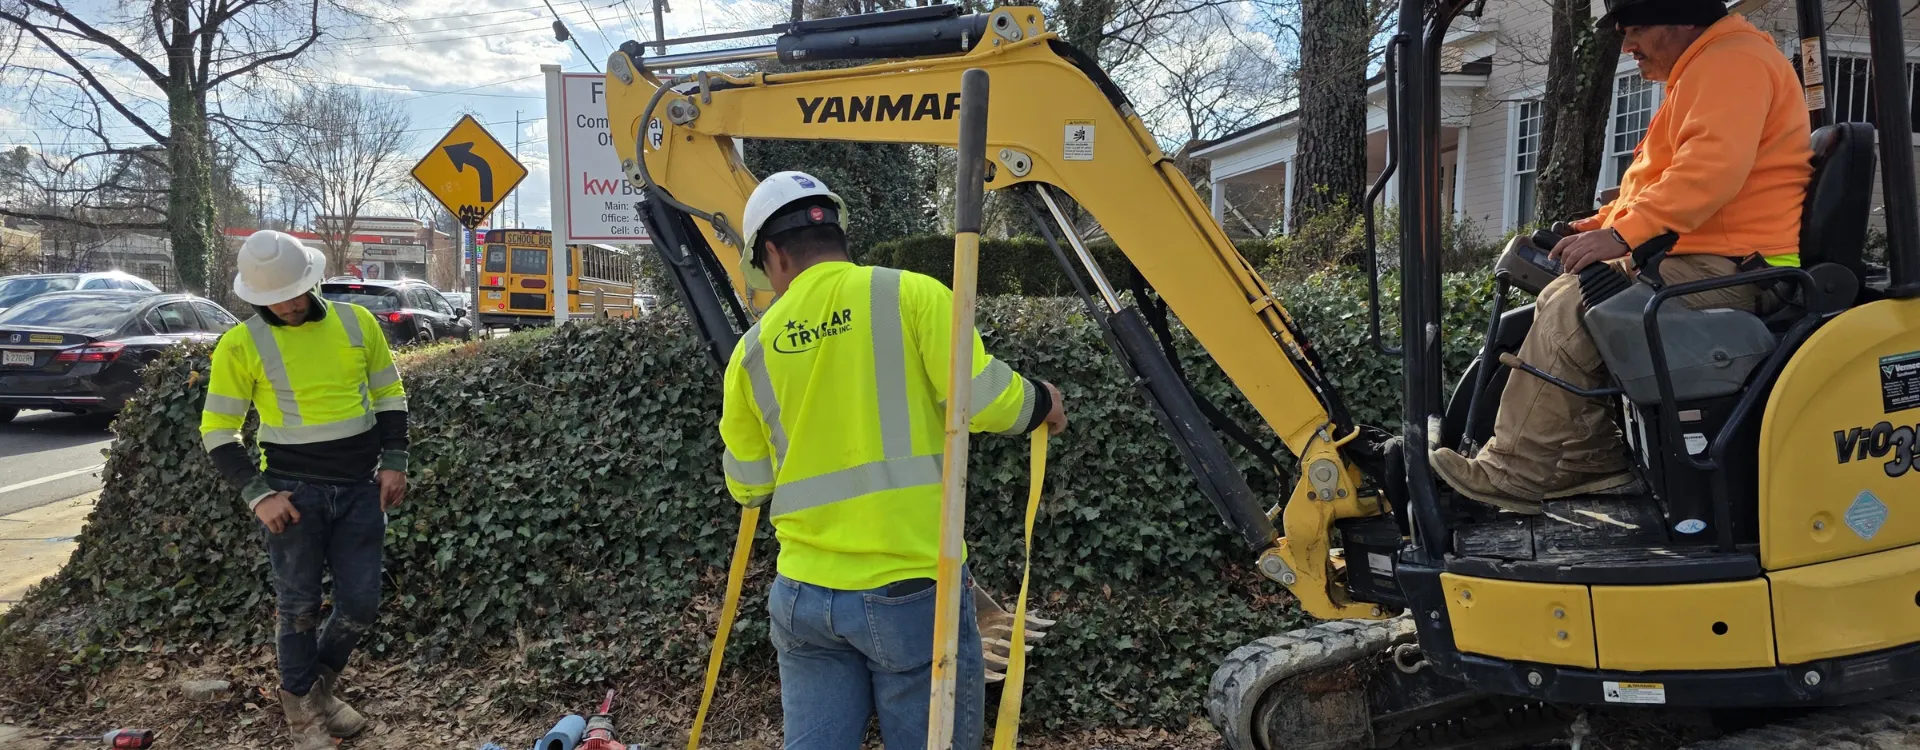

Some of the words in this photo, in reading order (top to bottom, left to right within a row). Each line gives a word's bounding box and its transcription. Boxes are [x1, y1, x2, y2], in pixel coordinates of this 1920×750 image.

[583, 171, 619, 196] kw
[604, 201, 629, 211] Main:
[601, 213, 629, 223] Office:
[610, 225, 630, 235] Cell:
[507, 233, 535, 244] SCHOOL
[538, 235, 553, 245] BUS
